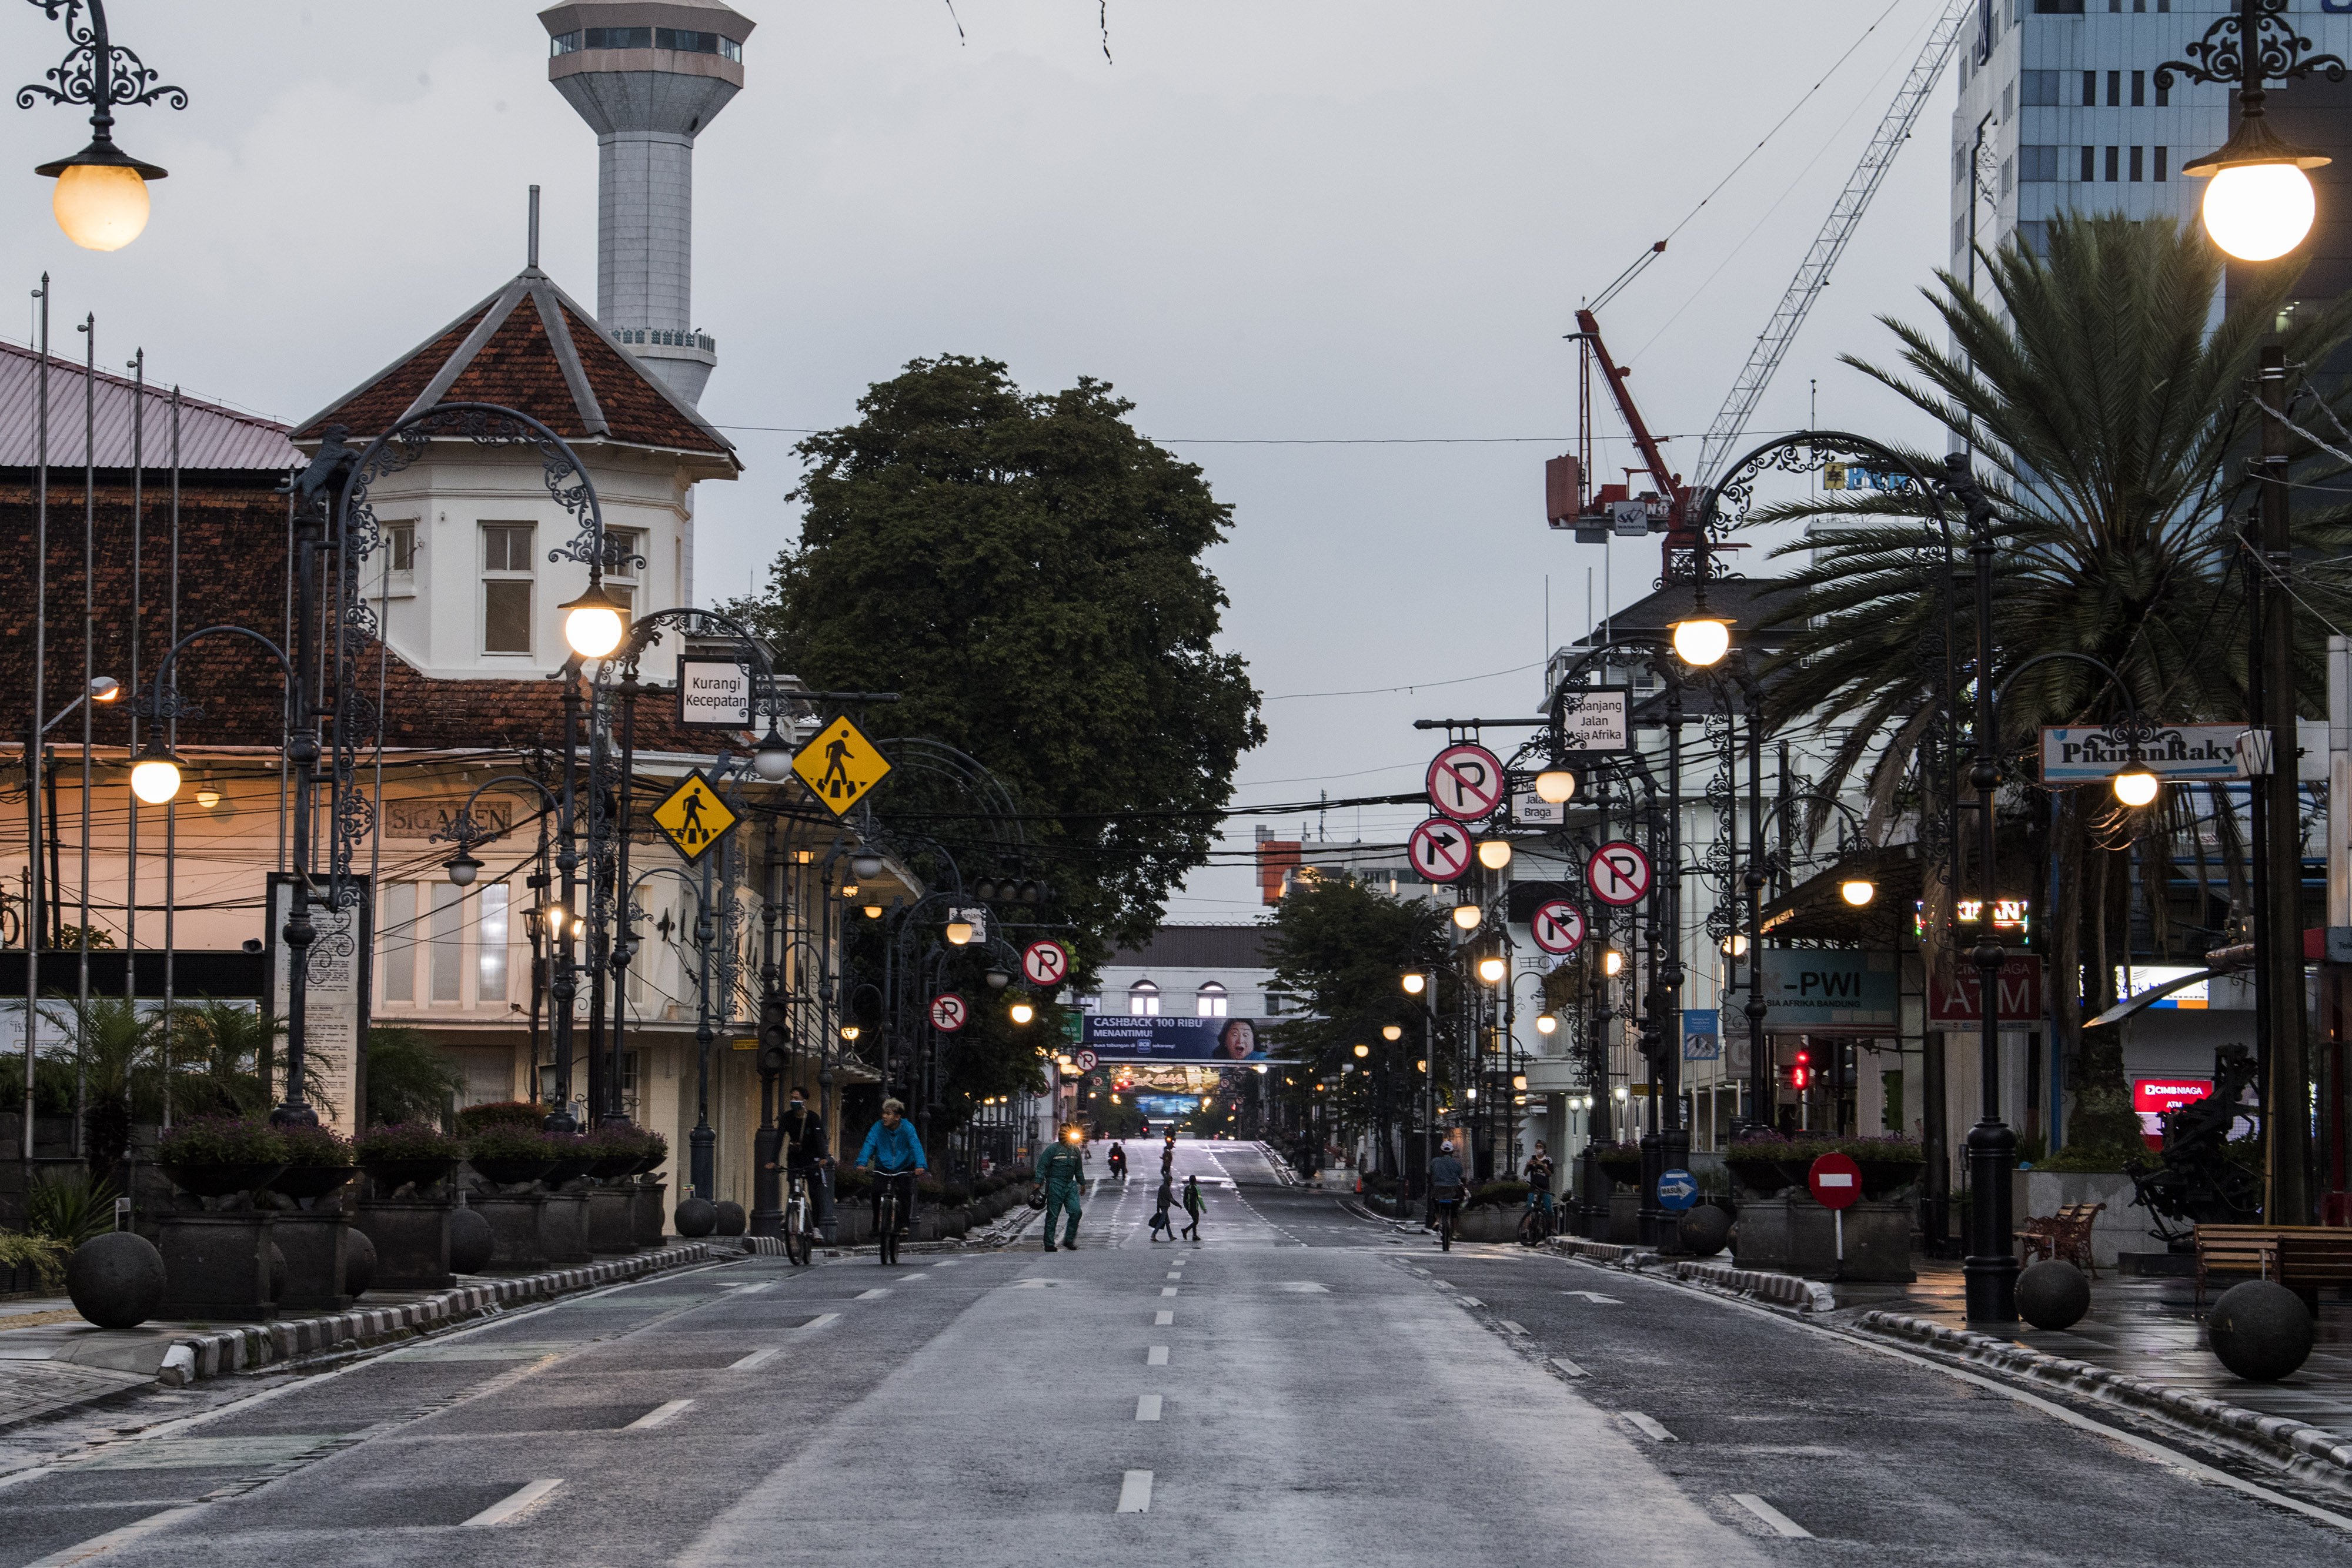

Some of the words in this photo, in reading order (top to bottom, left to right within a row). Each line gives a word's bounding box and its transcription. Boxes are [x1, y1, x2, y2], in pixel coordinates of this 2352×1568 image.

[693, 677, 740, 693] Kurangi
[686, 694, 747, 710] Kecepatan
[1573, 700, 1622, 713] panjang
[1581, 716, 1608, 726] Jalan
[1592, 730, 1622, 740] Afrika
[1525, 795, 1550, 804] Jala
[1525, 808, 1551, 818] Braga
[1094, 1018, 1152, 1027] CASHBACK
[1156, 1018, 1175, 1027] 100
[1177, 1019, 1203, 1028] RIBU
